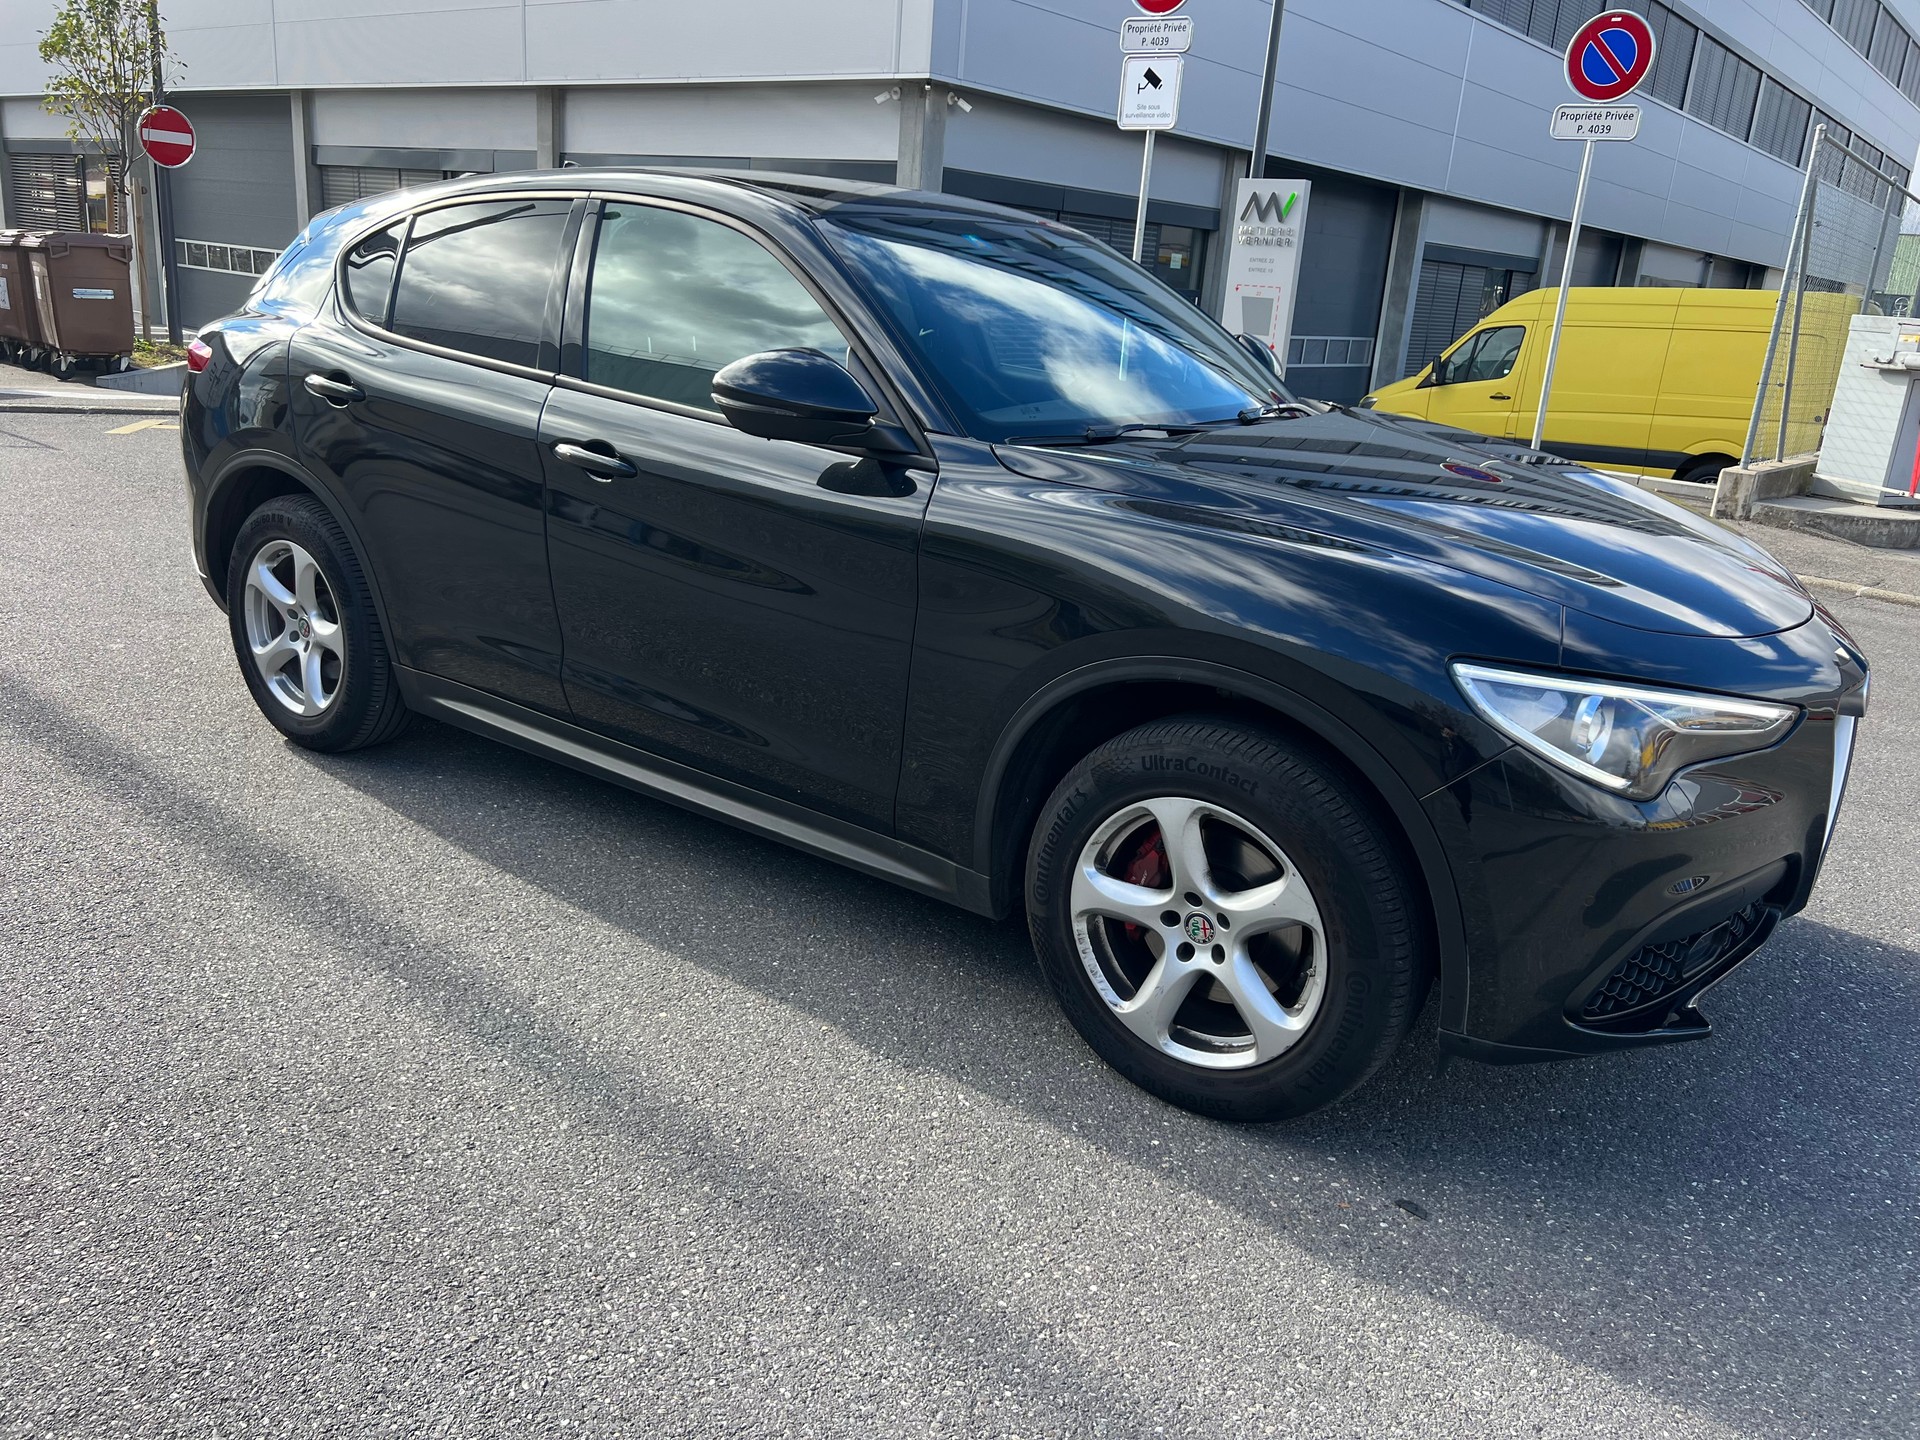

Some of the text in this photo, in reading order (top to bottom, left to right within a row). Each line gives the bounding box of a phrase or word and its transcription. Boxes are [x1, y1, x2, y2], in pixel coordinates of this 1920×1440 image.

[1127, 22, 1187, 35] Propriété Privée
[1141, 36, 1169, 46] P. 4039
[1136, 103, 1147, 111] Site
[1156, 111, 1171, 119] vidéo
[1560, 110, 1634, 122] Propriété Privée
[1576, 124, 1611, 134] P. 4039
[1237, 235, 1292, 247] VERNIER
[1141, 754, 1260, 797] UltraContact
[1032, 796, 1080, 906] Continental
